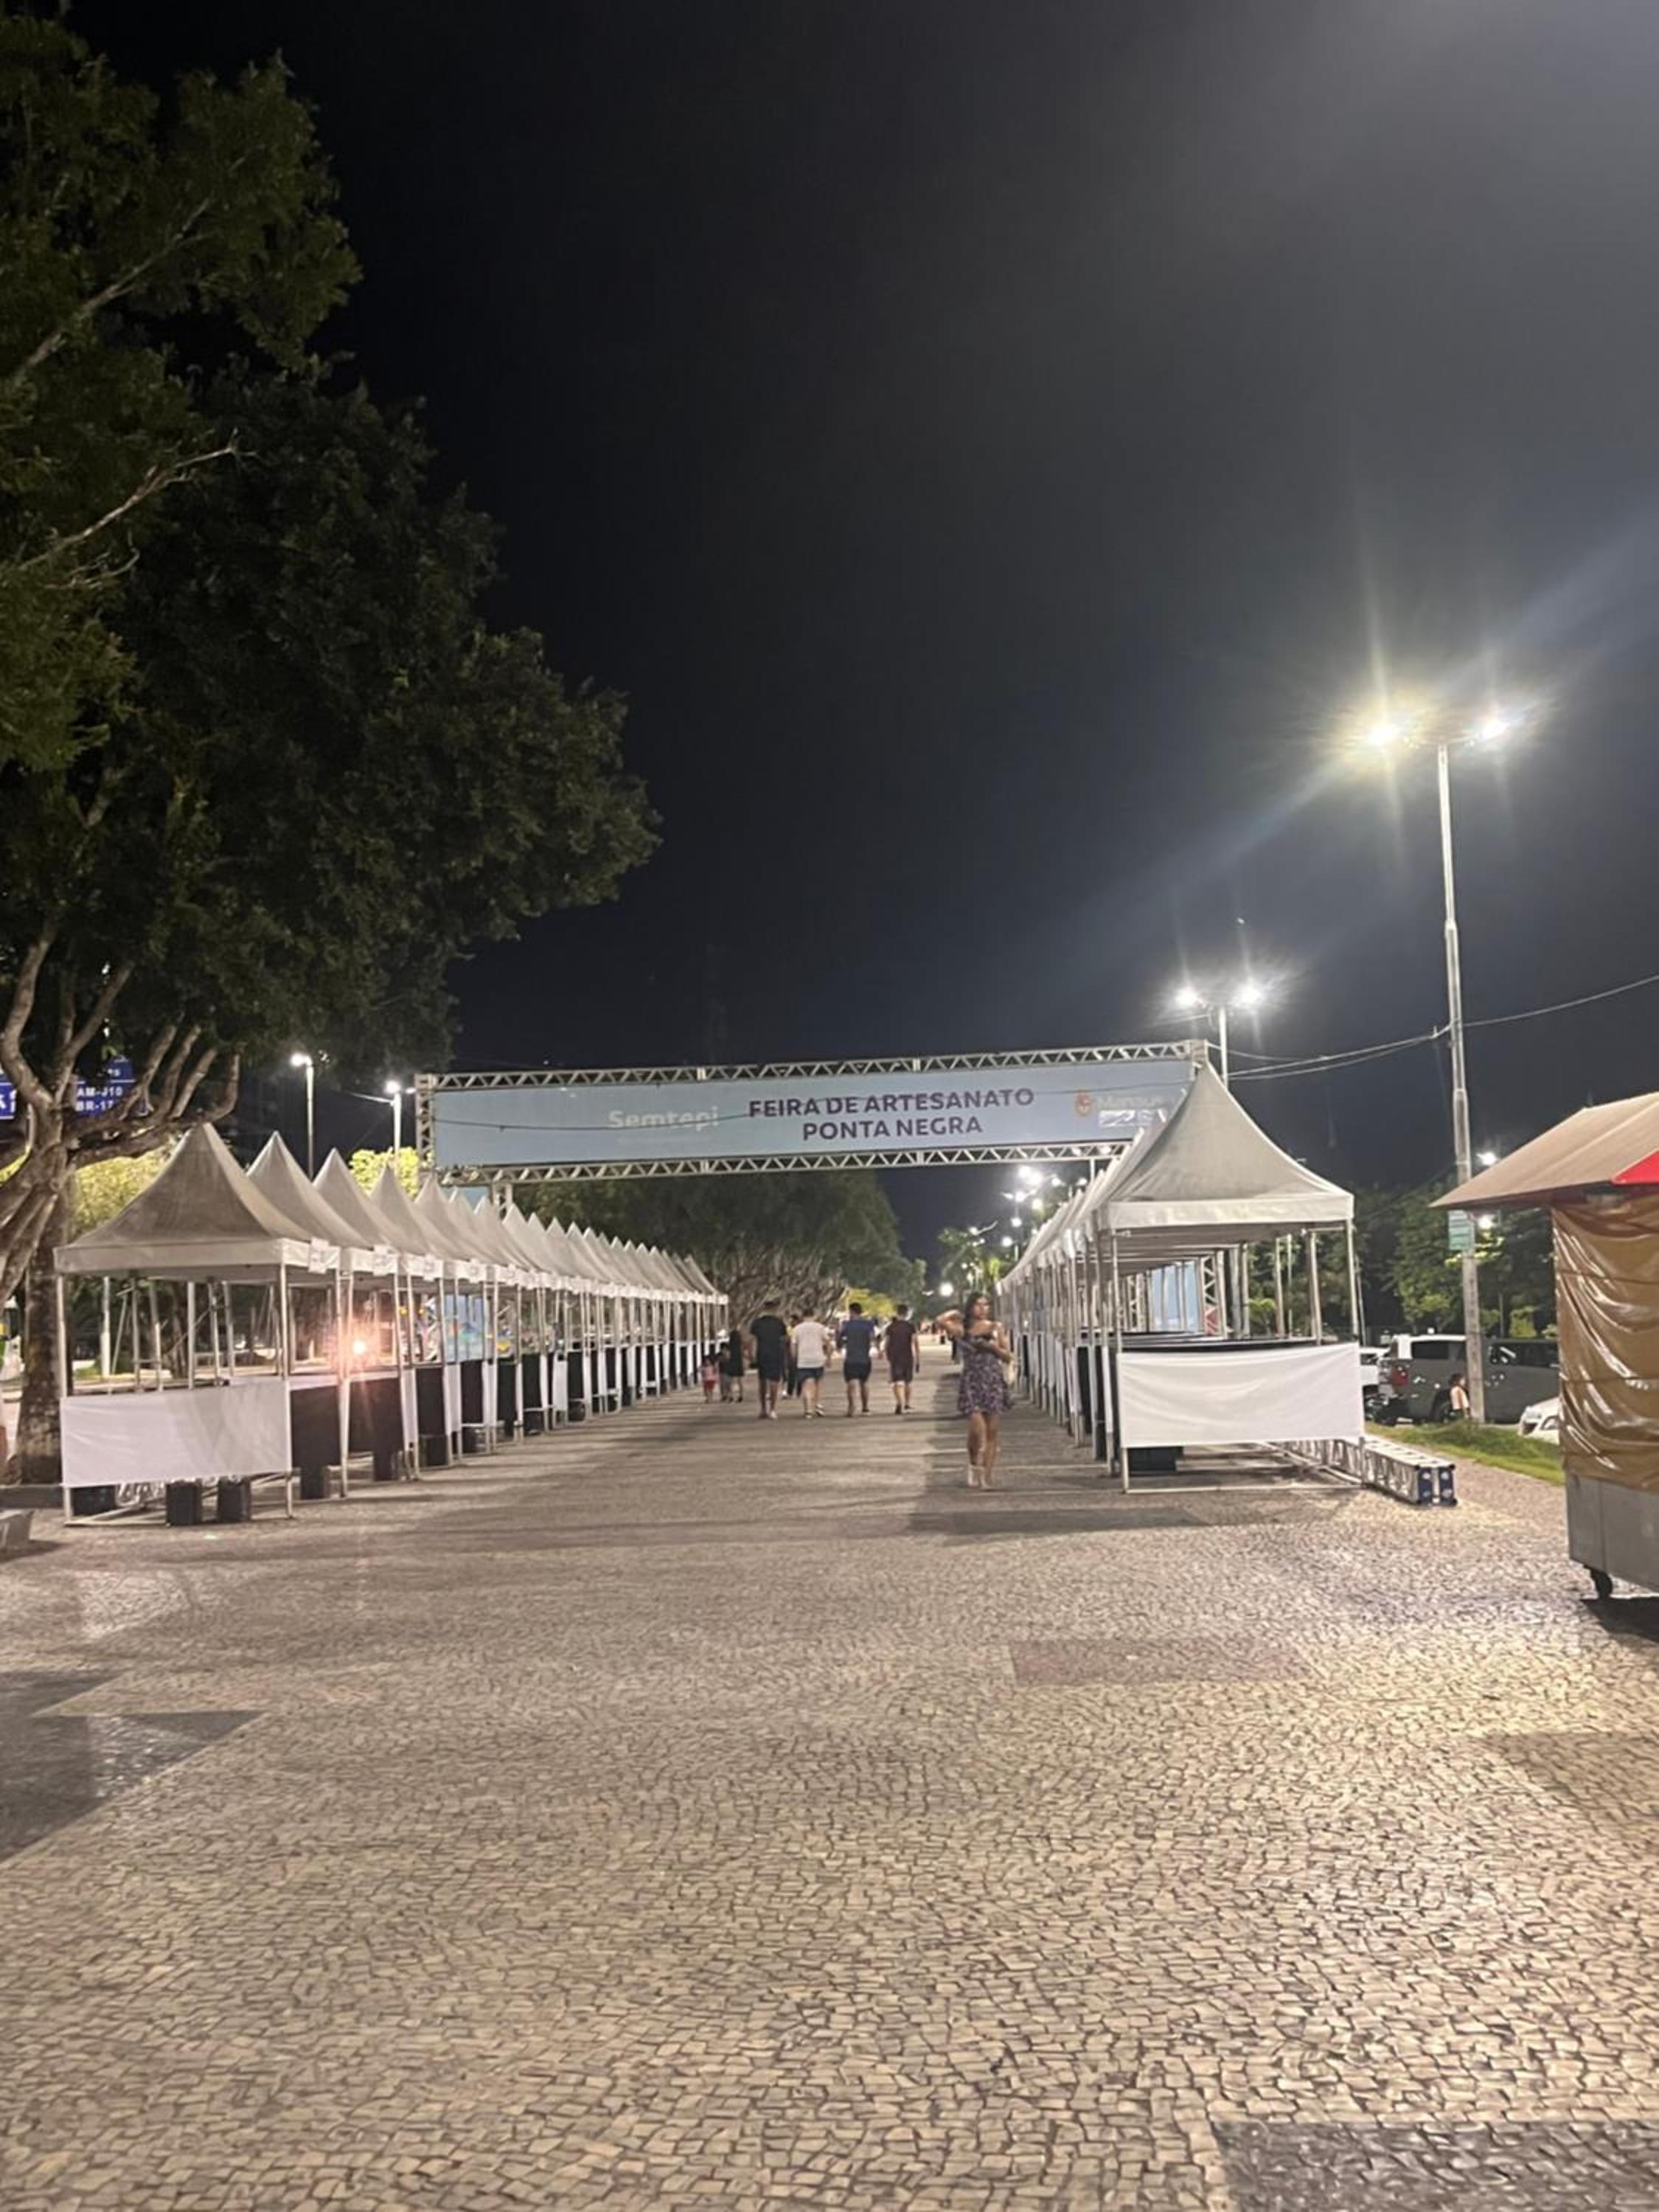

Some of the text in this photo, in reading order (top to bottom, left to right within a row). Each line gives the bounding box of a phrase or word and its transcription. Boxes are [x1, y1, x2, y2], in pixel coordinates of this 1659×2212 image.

[748, 1088, 1034, 1117] FEIRA DE ARTESANATO
[608, 1106, 718, 1132] Semtepi
[803, 1116, 983, 1141] PONTA NEGRA
